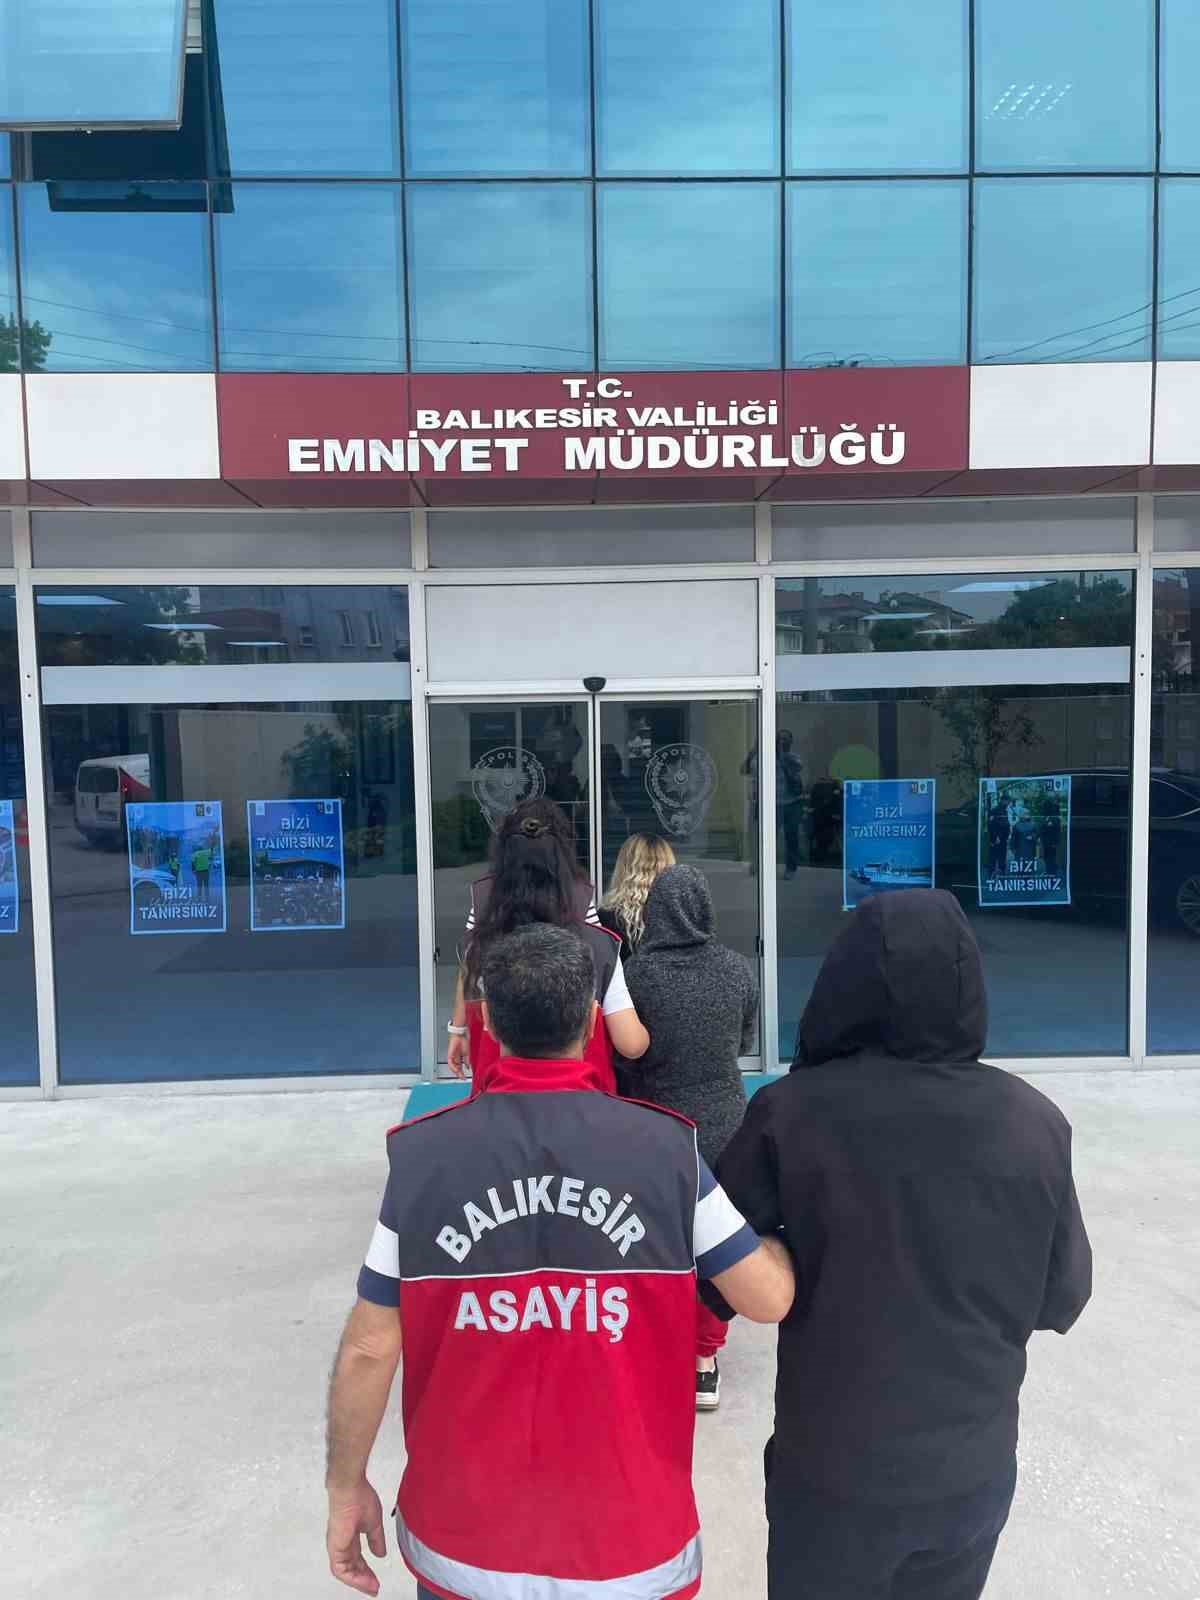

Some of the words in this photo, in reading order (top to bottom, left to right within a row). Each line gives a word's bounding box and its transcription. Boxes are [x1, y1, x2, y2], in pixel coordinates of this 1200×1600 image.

[563, 378, 633, 399] T.C.
[416, 402, 618, 430] BALIKESİR
[626, 400, 778, 427] VALİLİĞİ
[288, 430, 529, 472] EMNİYET
[564, 424, 906, 470] MÜDÜRLÜĞÜ
[1009, 856, 1038, 873] BİZİ
[985, 878, 1062, 892] TANIRSINIZ
[139, 905, 217, 920] TANIRSINIZ
[435, 1175, 646, 1263] BALIKESİR
[454, 1278, 630, 1343] ASAYİŞ
